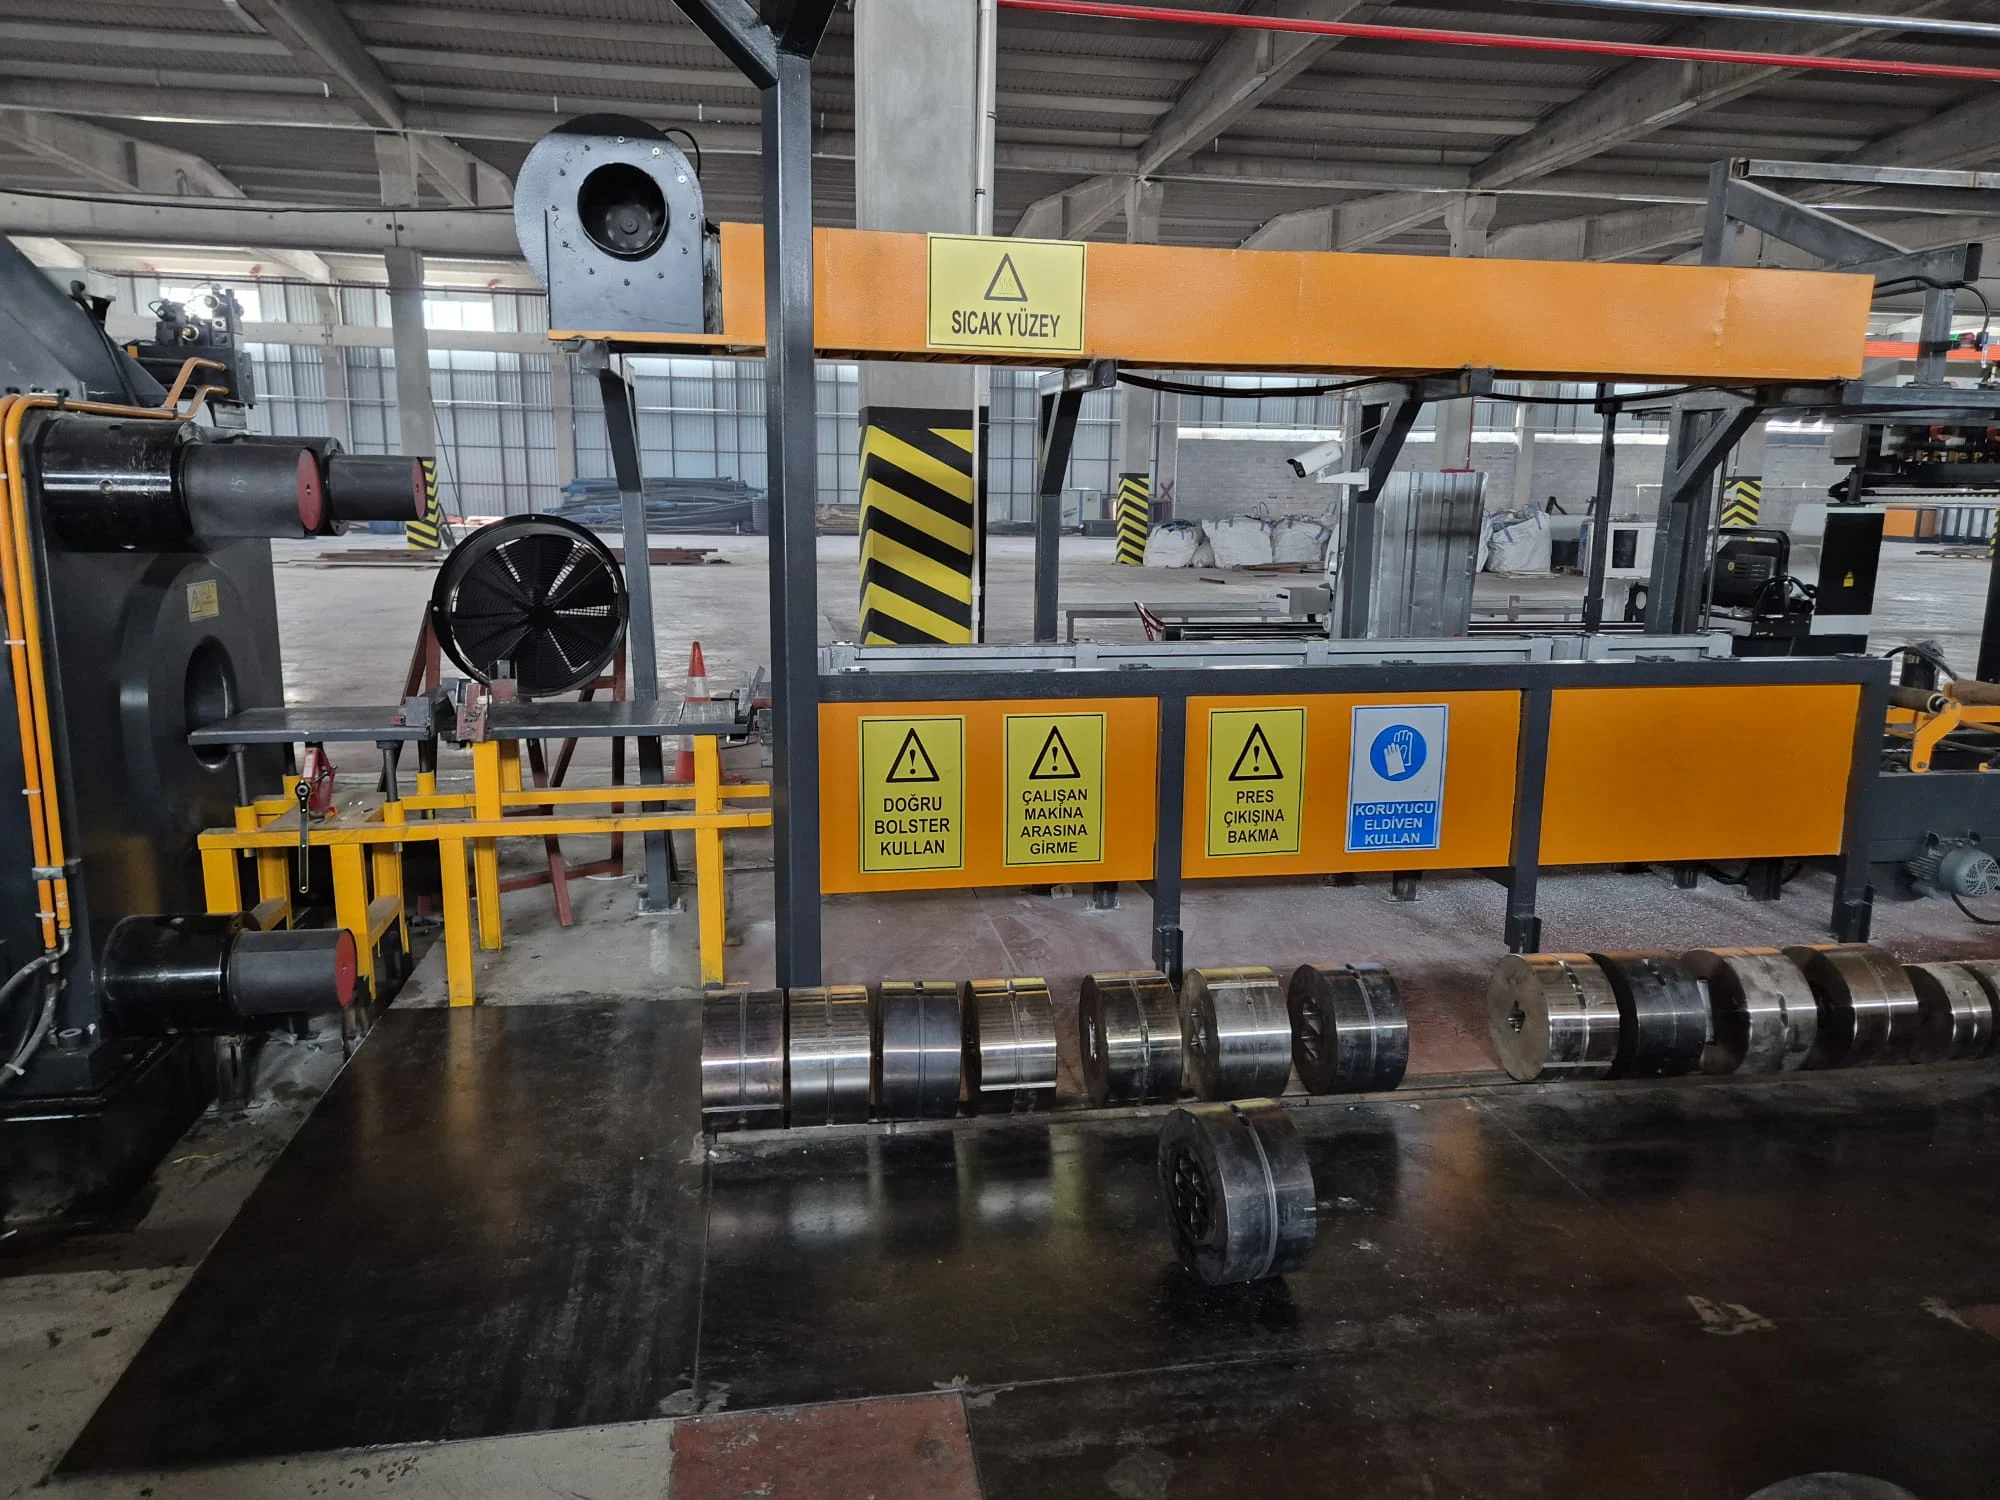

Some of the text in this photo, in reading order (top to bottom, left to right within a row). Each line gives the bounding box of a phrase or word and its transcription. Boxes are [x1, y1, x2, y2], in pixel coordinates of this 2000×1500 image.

[951, 308, 1061, 338] SICAK YÜZEY
[883, 793, 942, 813] DOĞRU
[1022, 788, 1088, 805] ÇALIŞAN
[1236, 789, 1274, 804] PRES
[1024, 804, 1084, 821] MAKİNA
[1355, 803, 1434, 816] KORUYUCU
[874, 818, 950, 835] BOLSTER
[1223, 810, 1285, 828] ÇIKIŞINA
[1364, 815, 1423, 831] ELDİVEN
[1020, 823, 1088, 838] ARASINA
[1227, 829, 1279, 844] BAKMA
[1364, 832, 1420, 845] KULLAN
[880, 839, 945, 856] KULLAN
[1030, 840, 1078, 855] GİRME
